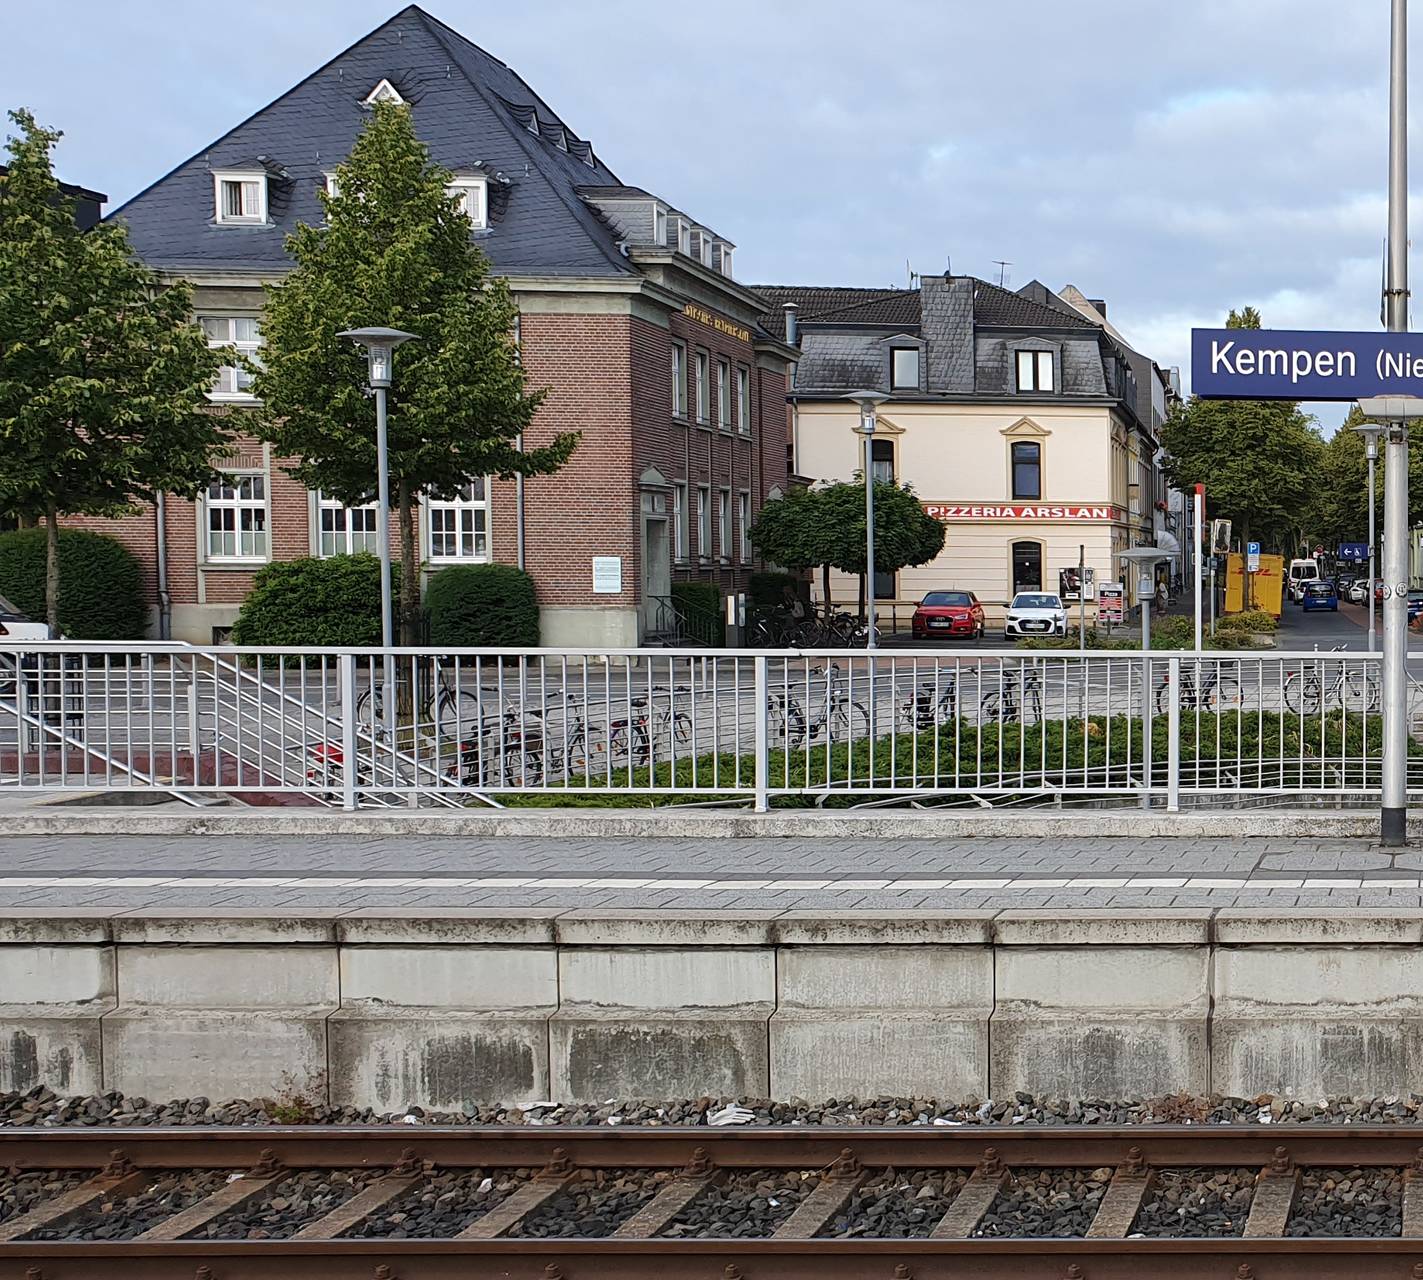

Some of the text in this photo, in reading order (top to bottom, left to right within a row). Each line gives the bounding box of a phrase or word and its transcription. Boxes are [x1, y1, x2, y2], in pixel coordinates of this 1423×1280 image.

[1211, 341, 1356, 383] Kempen
[927, 506, 1108, 518] PIZZERIA ARSLAN
[1250, 544, 1257, 552] P
